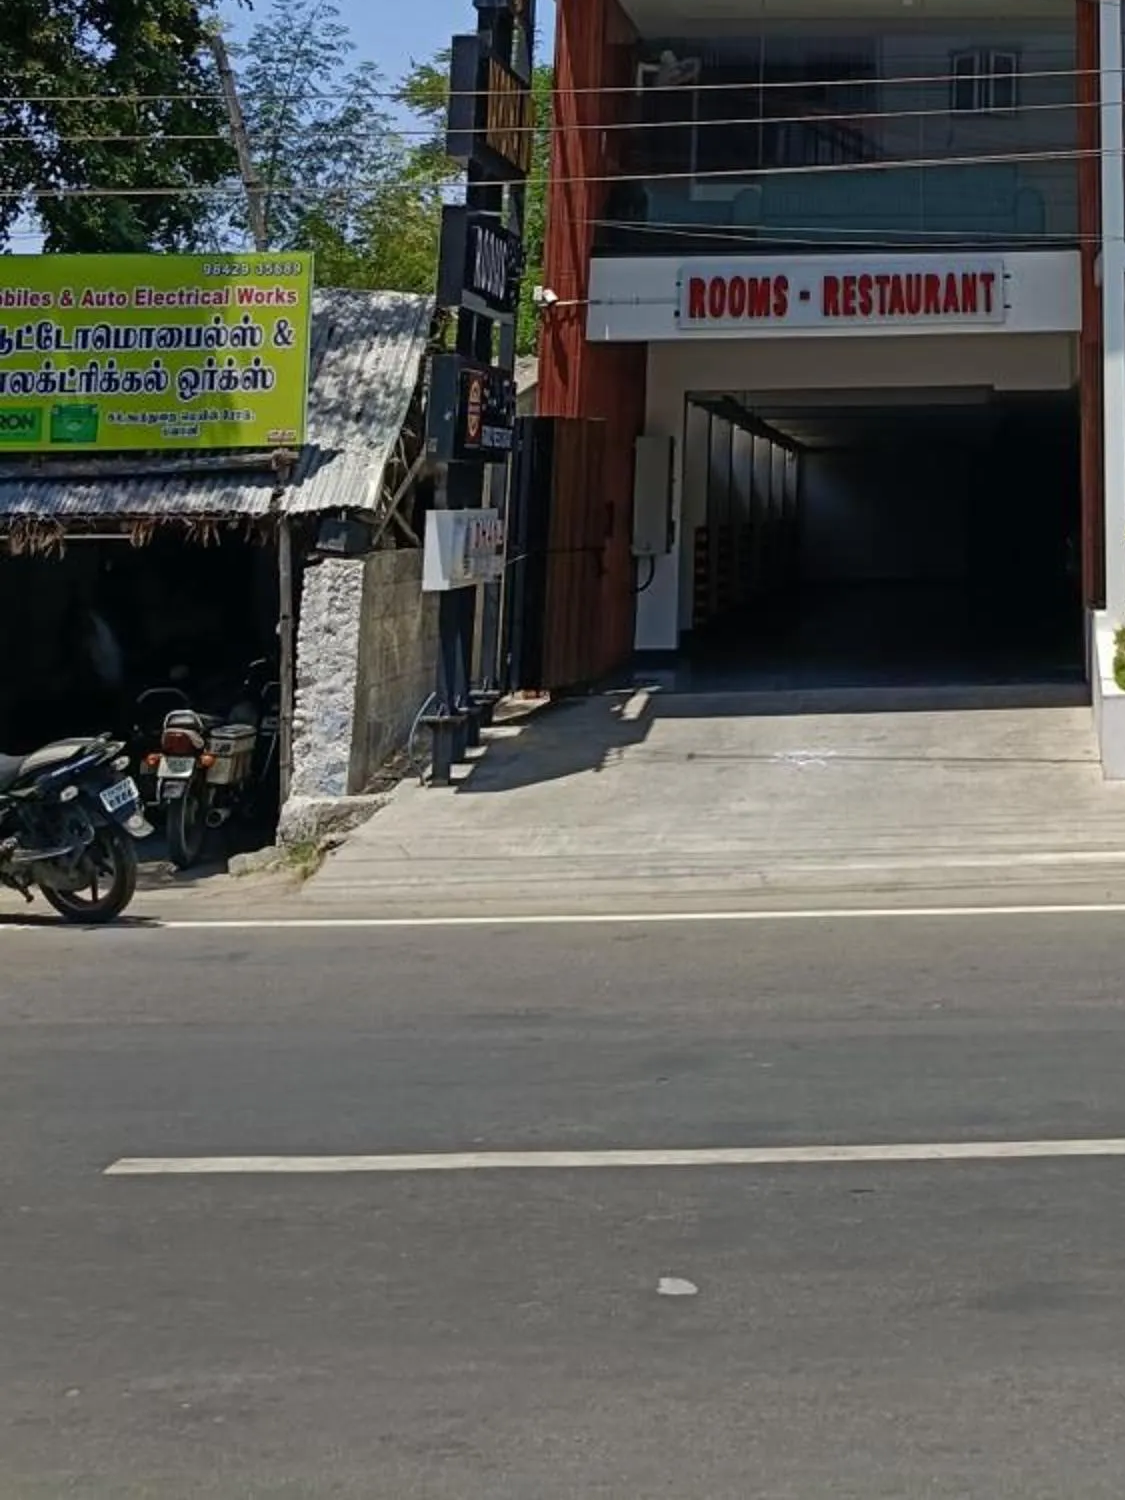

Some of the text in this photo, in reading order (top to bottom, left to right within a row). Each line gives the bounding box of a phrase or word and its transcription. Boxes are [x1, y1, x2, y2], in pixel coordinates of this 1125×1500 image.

[60, 289, 73, 306] &
[82, 288, 126, 307] Auto
[136, 287, 228, 306] Electrical
[237, 286, 297, 305] Works
[689, 274, 789, 319] ROOMS
[823, 272, 995, 317] RESTAURANT
[274, 320, 293, 346] &
